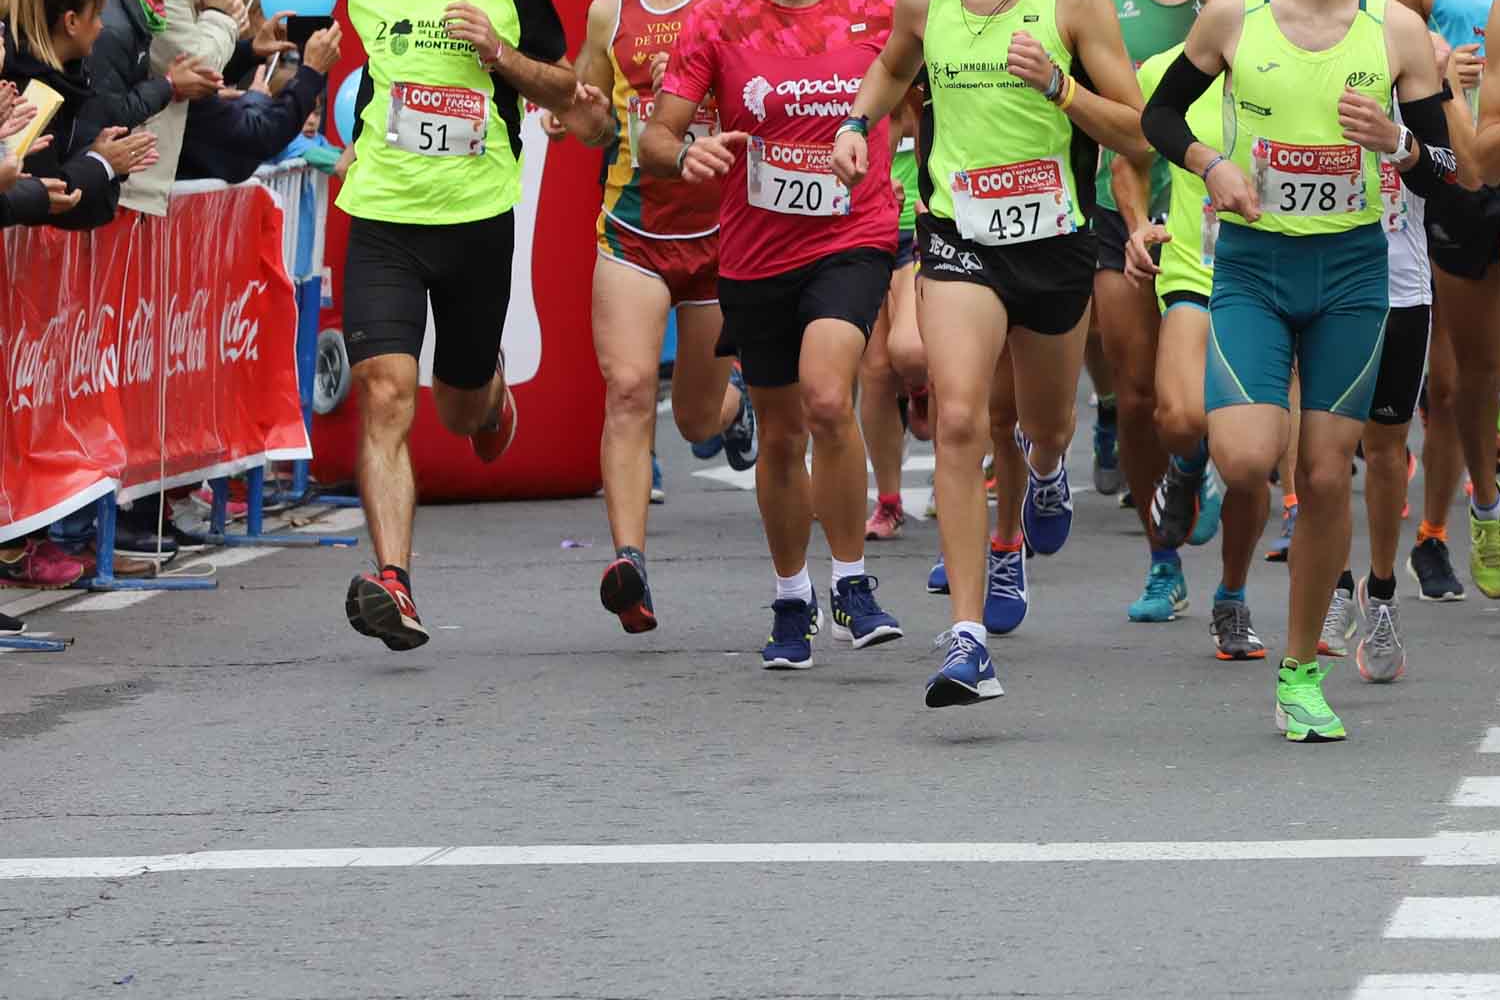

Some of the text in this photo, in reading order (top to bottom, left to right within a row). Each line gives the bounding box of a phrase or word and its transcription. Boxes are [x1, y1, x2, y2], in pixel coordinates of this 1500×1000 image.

[635, 35, 650, 47] DE
[647, 21, 681, 34] VINO
[784, 99, 853, 117] runnin
[418, 121, 450, 152] 51
[773, 177, 823, 211] 720
[1279, 182, 1337, 212] 378
[988, 201, 1041, 240] 437
